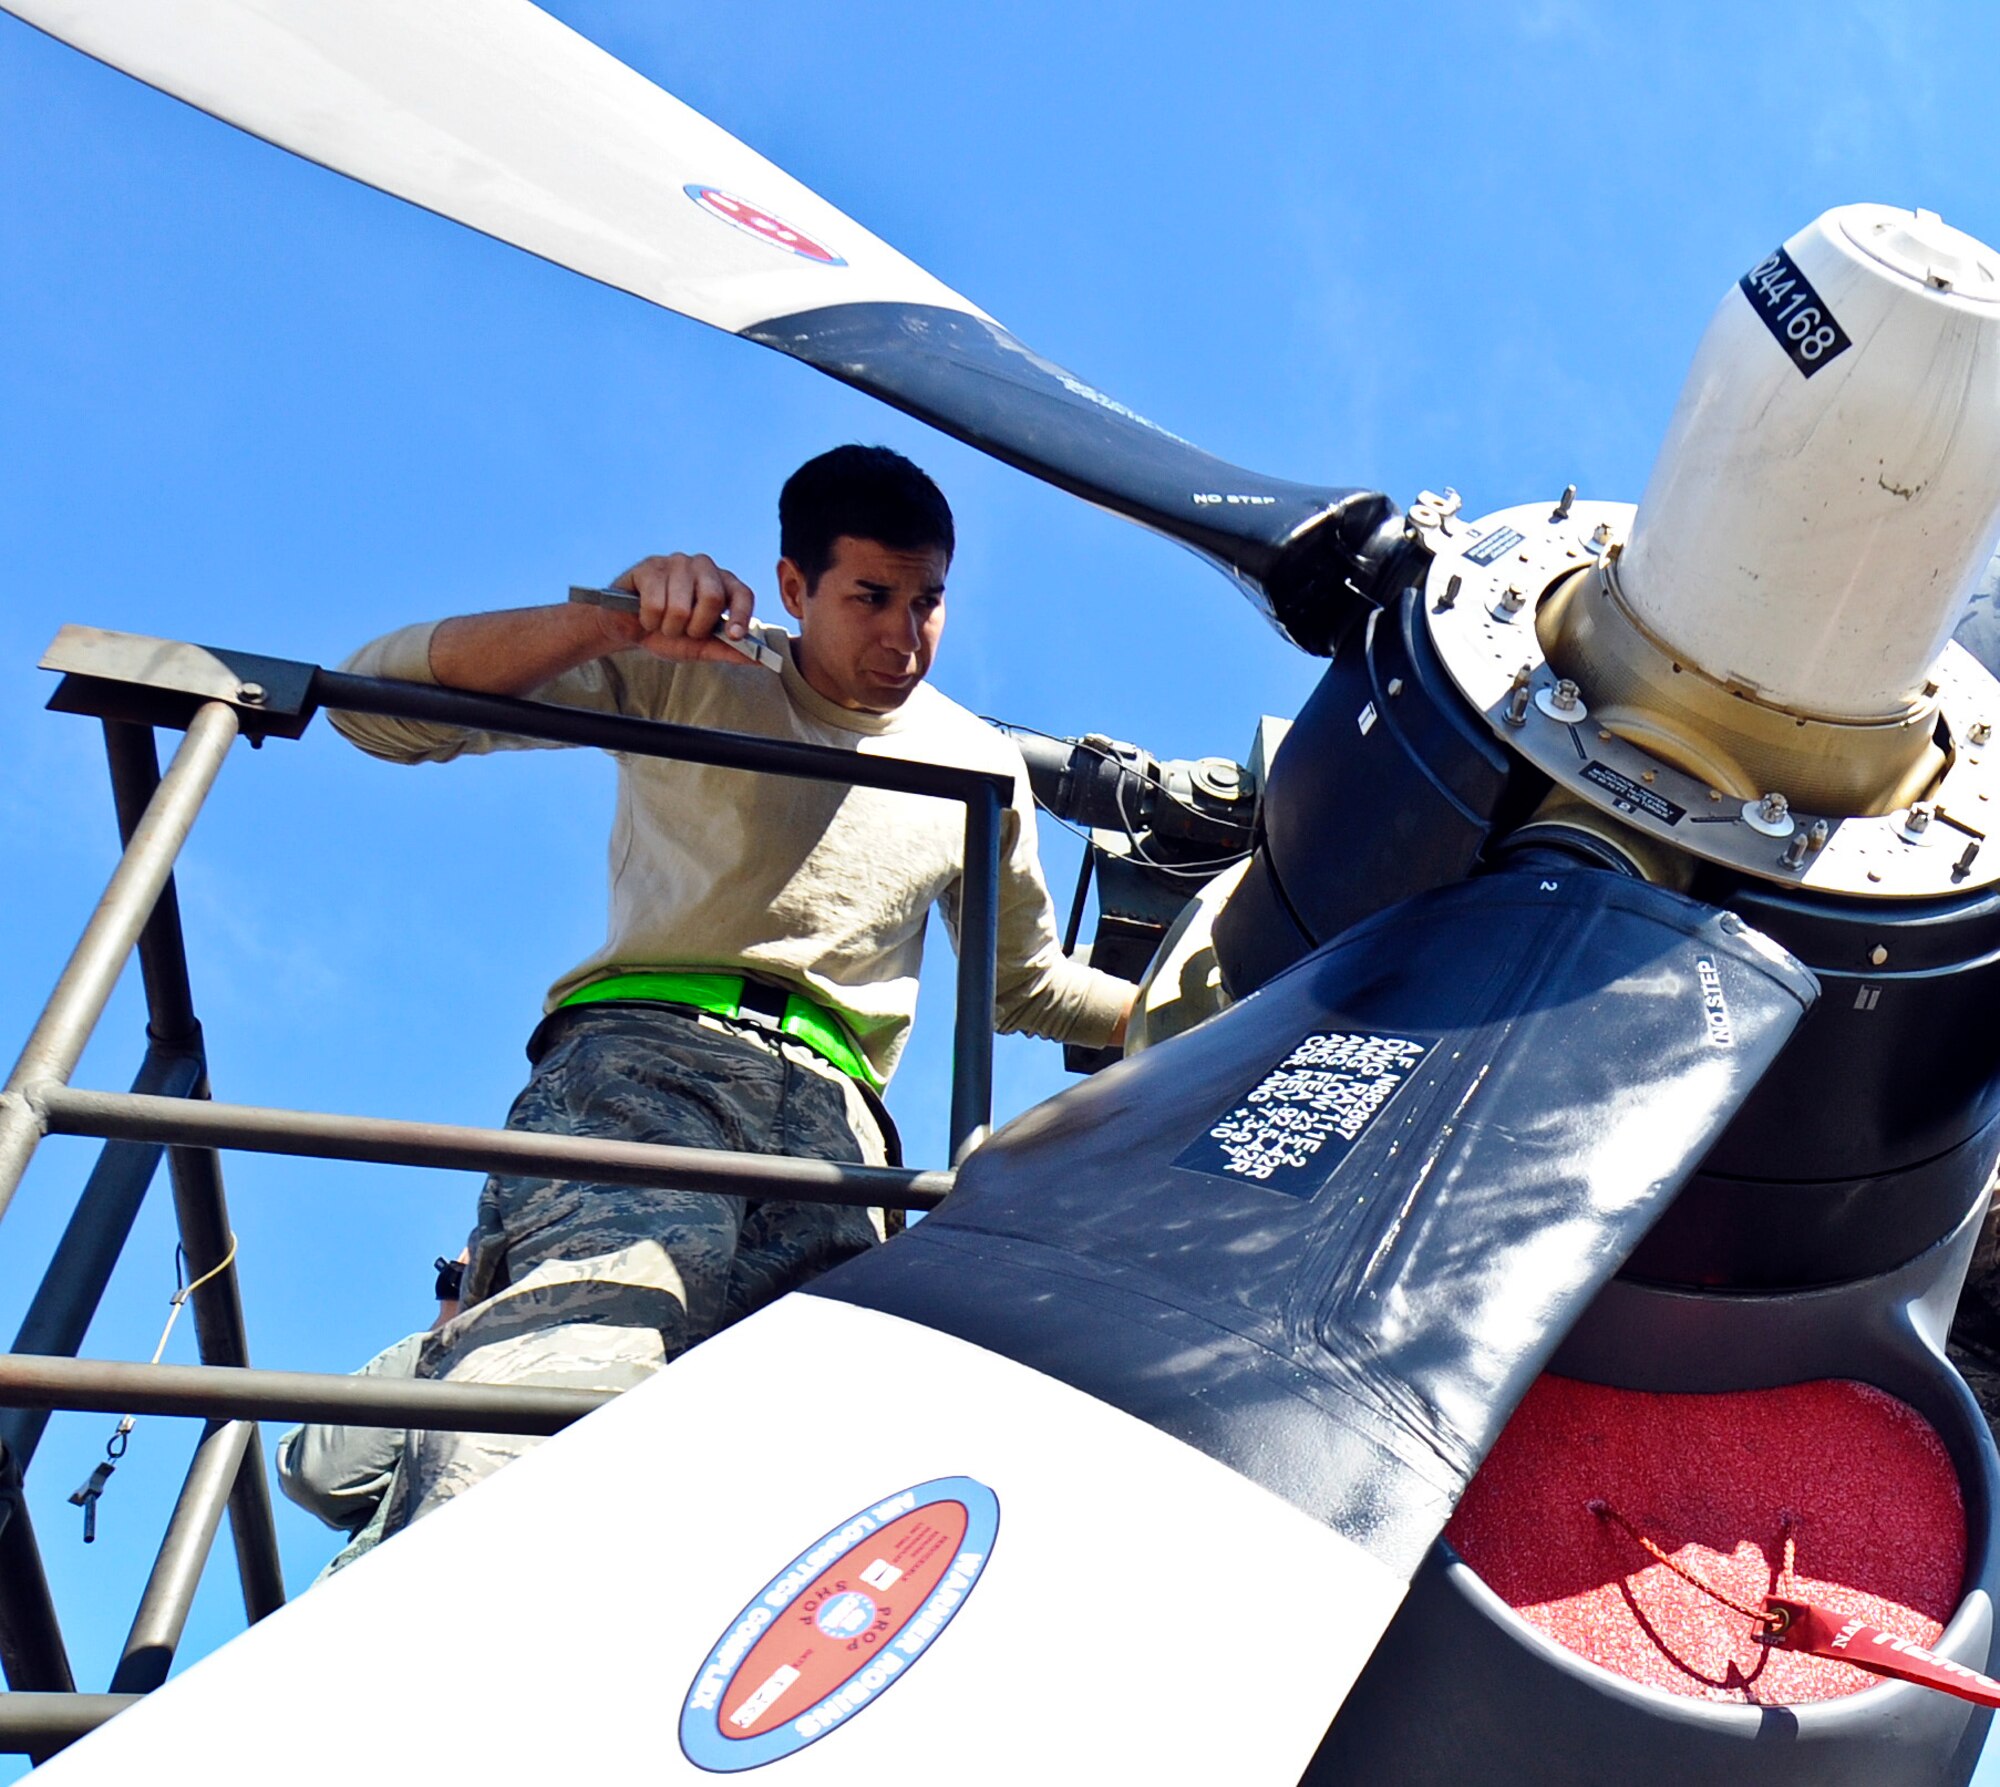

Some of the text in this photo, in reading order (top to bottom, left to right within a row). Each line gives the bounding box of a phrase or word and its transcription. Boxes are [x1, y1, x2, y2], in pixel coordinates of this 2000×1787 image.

[1193, 493, 1276, 505] NO STEP
[1697, 958, 1731, 1043] NO STEP
[1281, 1036, 1325, 1067] COR.
[1302, 1034, 1345, 1066] ANG.
[1321, 1035, 1361, 1067] ANG.
[1342, 1037, 1385, 1070] ANG.
[1248, 1071, 1285, 1102] ANG
[1273, 1069, 1309, 1100] REV
[1282, 1039, 1406, 1167] DWG. RA7111E-2
[1310, 1074, 1353, 1110] LOW
[1335, 1072, 1400, 1140] N882897
[764, 1516, 877, 1605] LOGISTICS
[799, 1581, 846, 1626] SHOP
[894, 1553, 983, 1654] WARNER
[847, 1605, 890, 1651] PROP
[690, 1608, 772, 1710] COMPLEX
[795, 1653, 904, 1738] ROBINS
